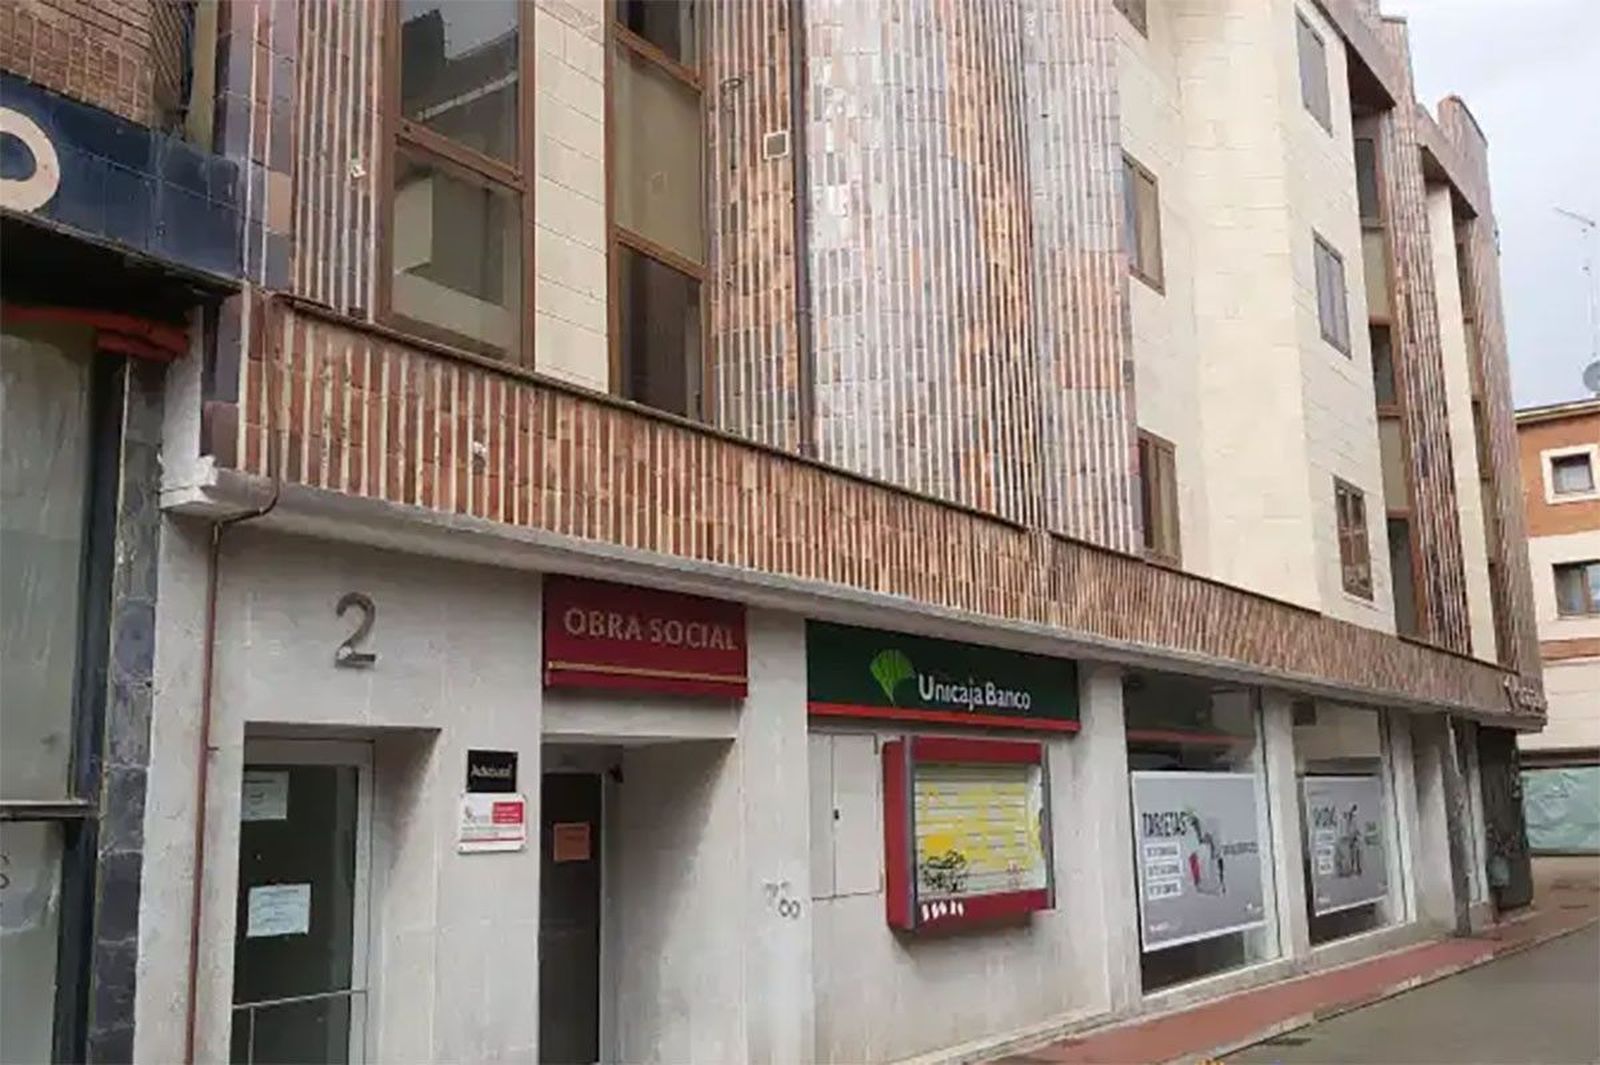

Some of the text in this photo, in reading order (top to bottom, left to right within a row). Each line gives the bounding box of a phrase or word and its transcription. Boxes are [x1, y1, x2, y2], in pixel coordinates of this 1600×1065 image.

[334, 592, 376, 669] 2
[563, 608, 739, 650] OBRA SOCIAL
[918, 673, 1031, 712] Unicaja Banco
